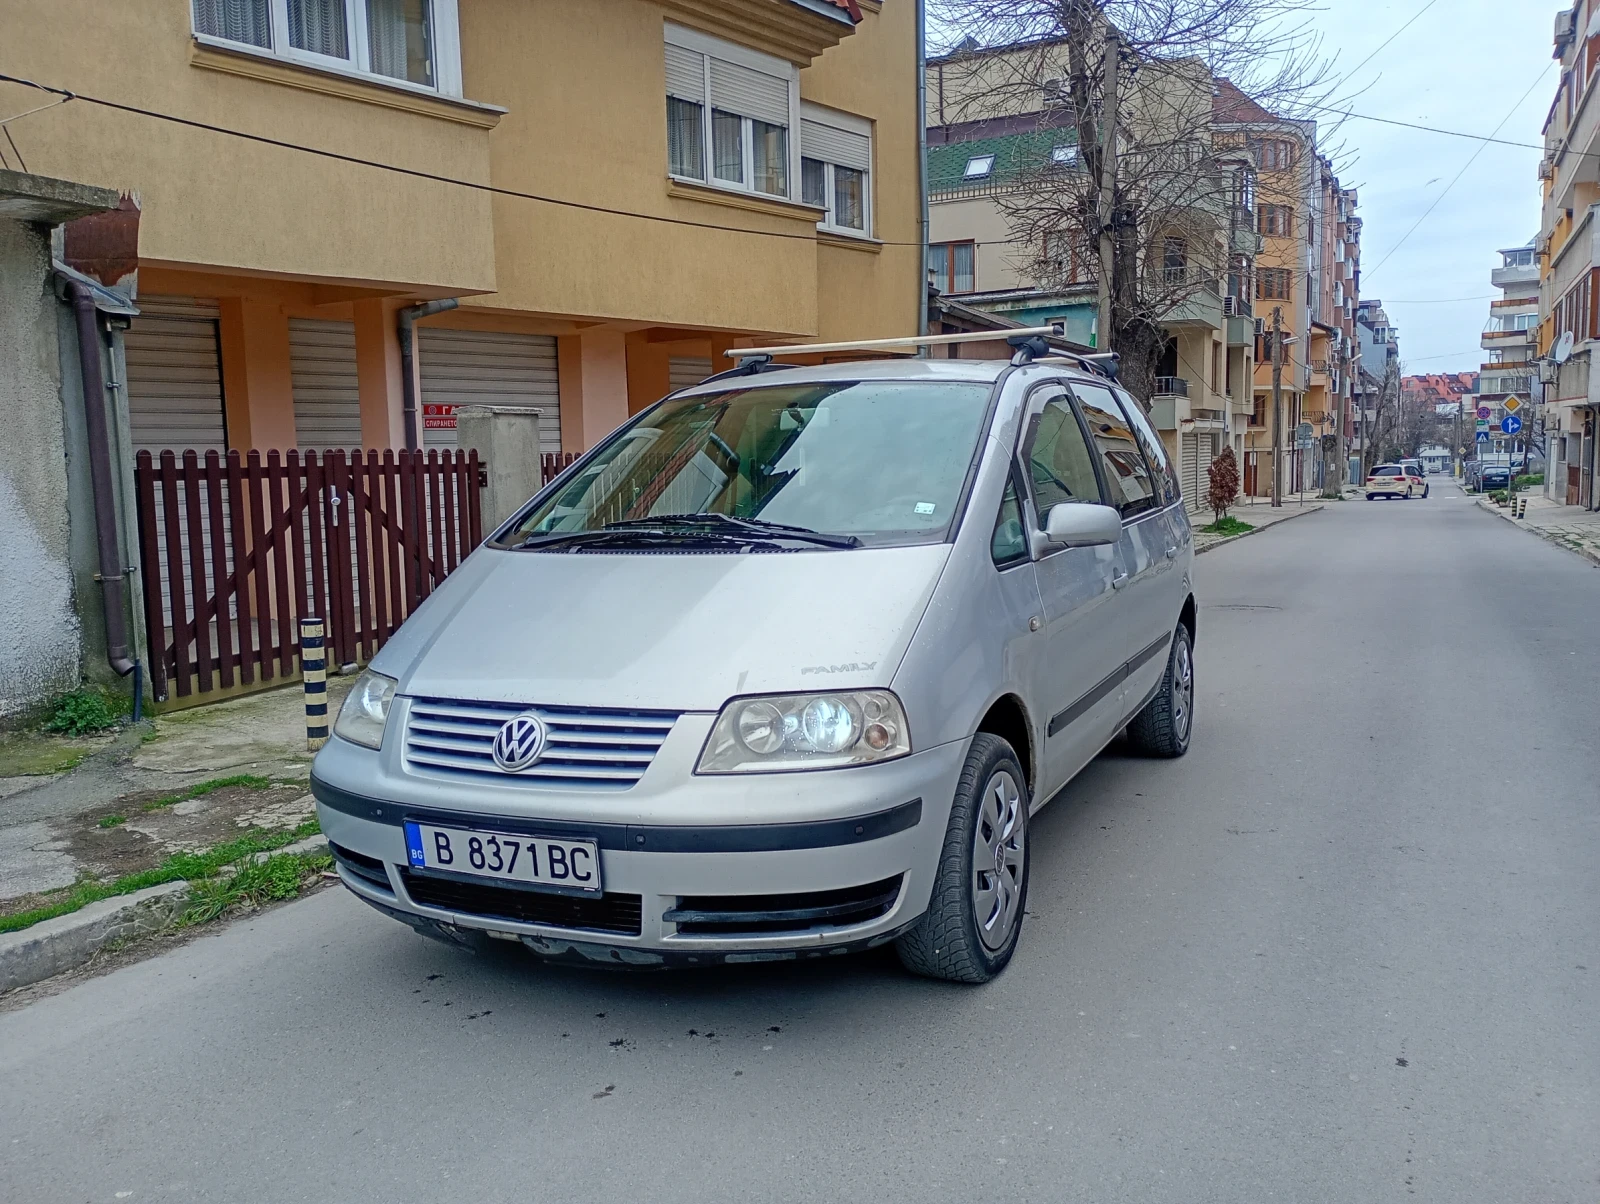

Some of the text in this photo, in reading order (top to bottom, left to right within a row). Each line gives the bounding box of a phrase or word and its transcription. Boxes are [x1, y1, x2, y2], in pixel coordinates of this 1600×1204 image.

[801, 661, 877, 675] FAMILY
[411, 849, 423, 860] BG
[434, 831, 454, 865] B
